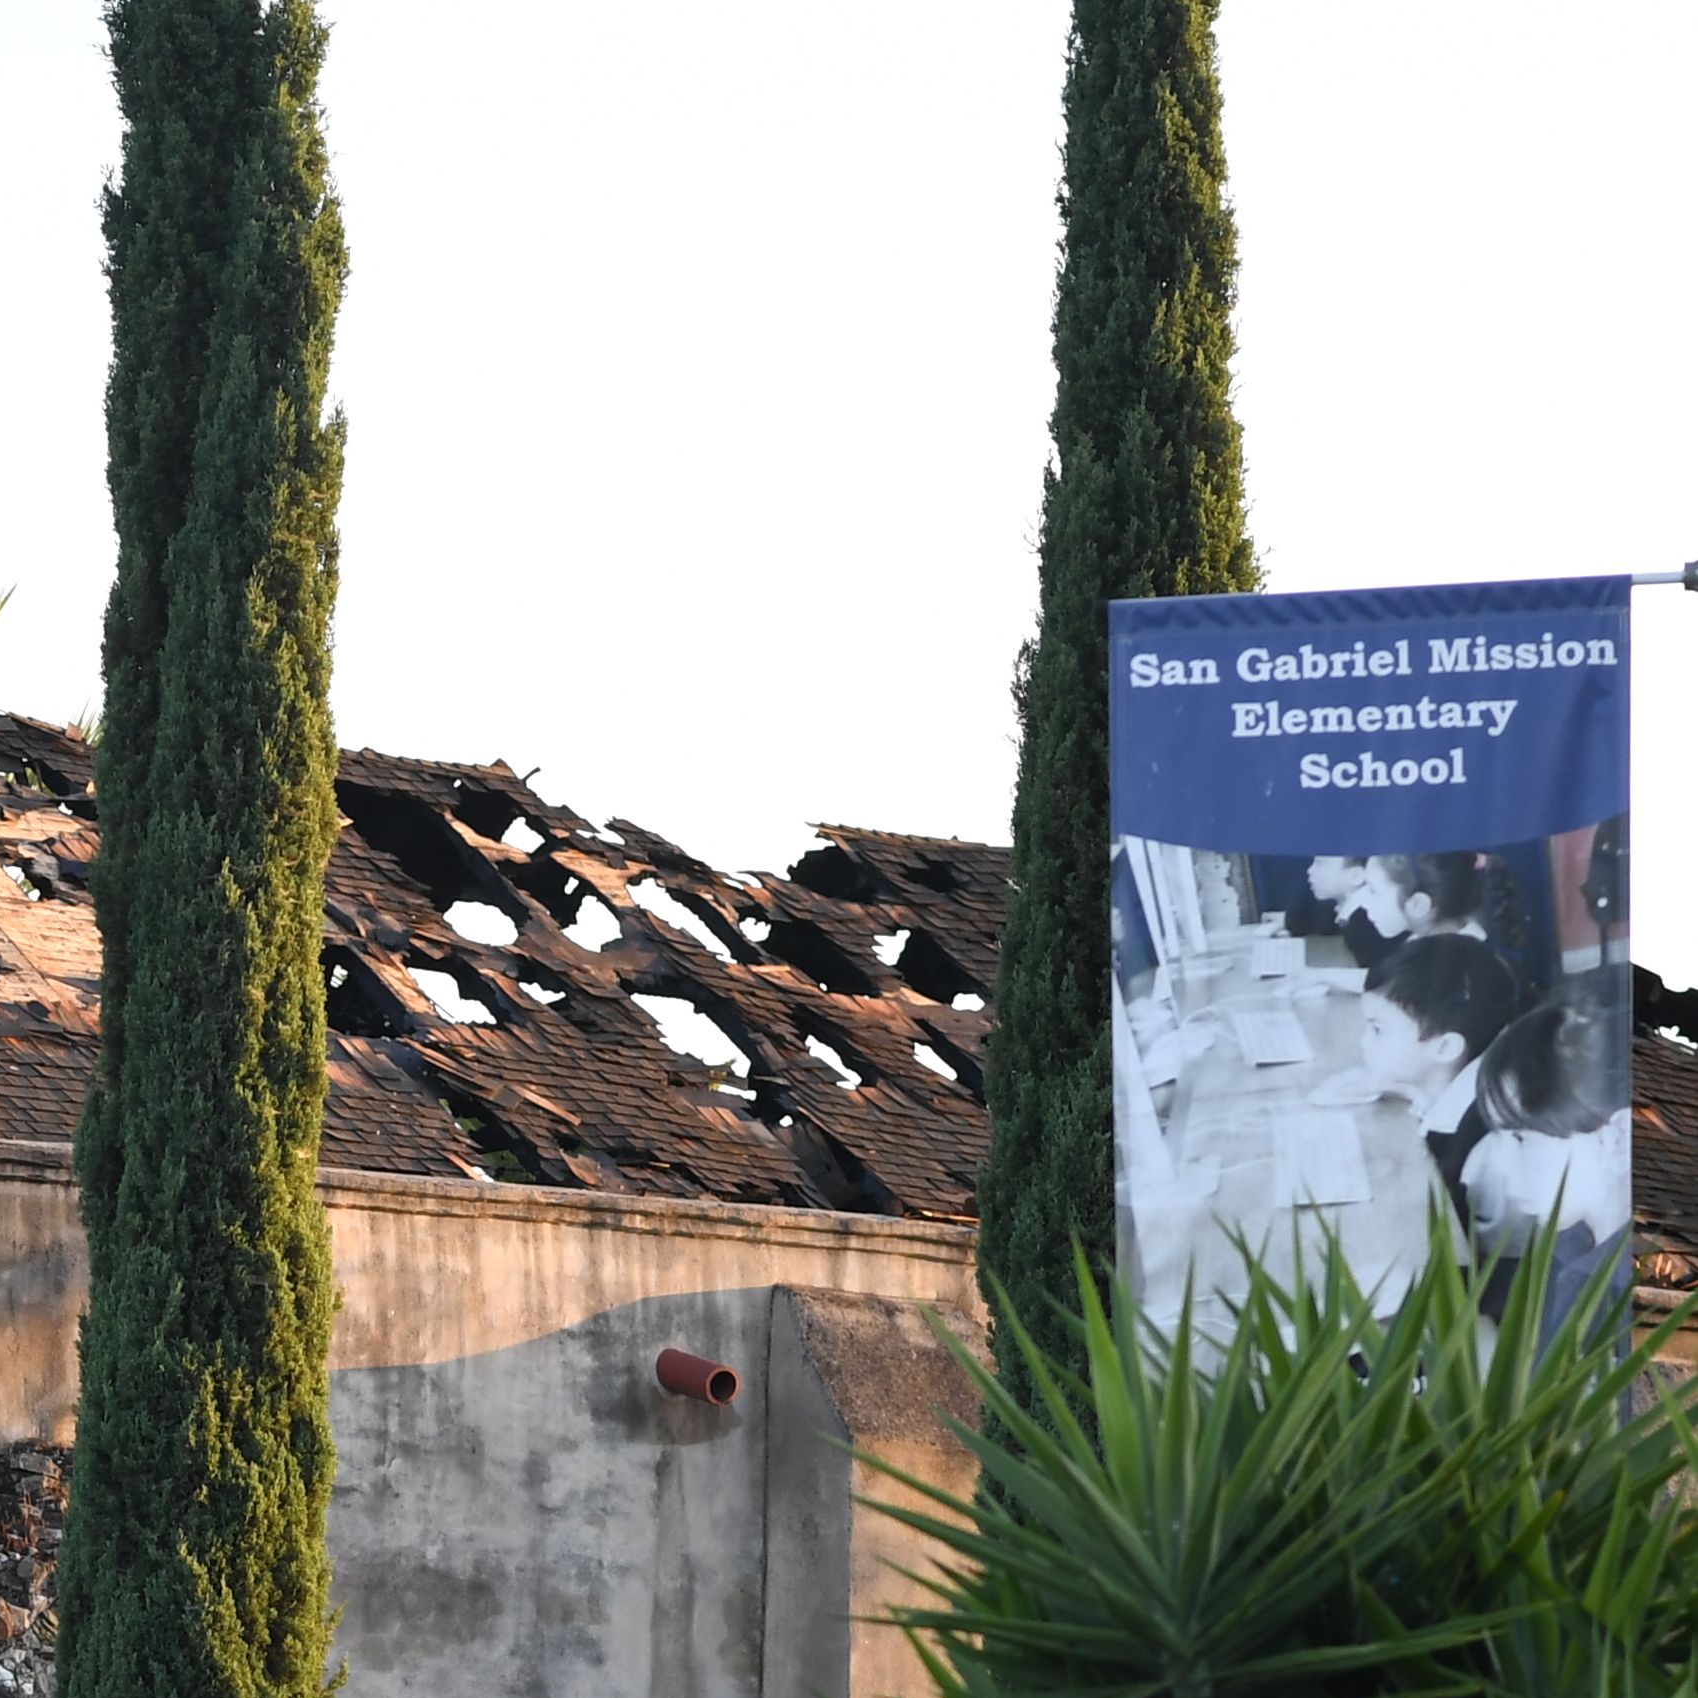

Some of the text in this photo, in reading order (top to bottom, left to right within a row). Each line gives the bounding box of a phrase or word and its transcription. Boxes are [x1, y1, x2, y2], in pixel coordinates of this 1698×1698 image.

[1129, 632, 1618, 687] San Gabriel Mission
[1231, 695, 1518, 738] Elementary
[1300, 747, 1467, 788] School
